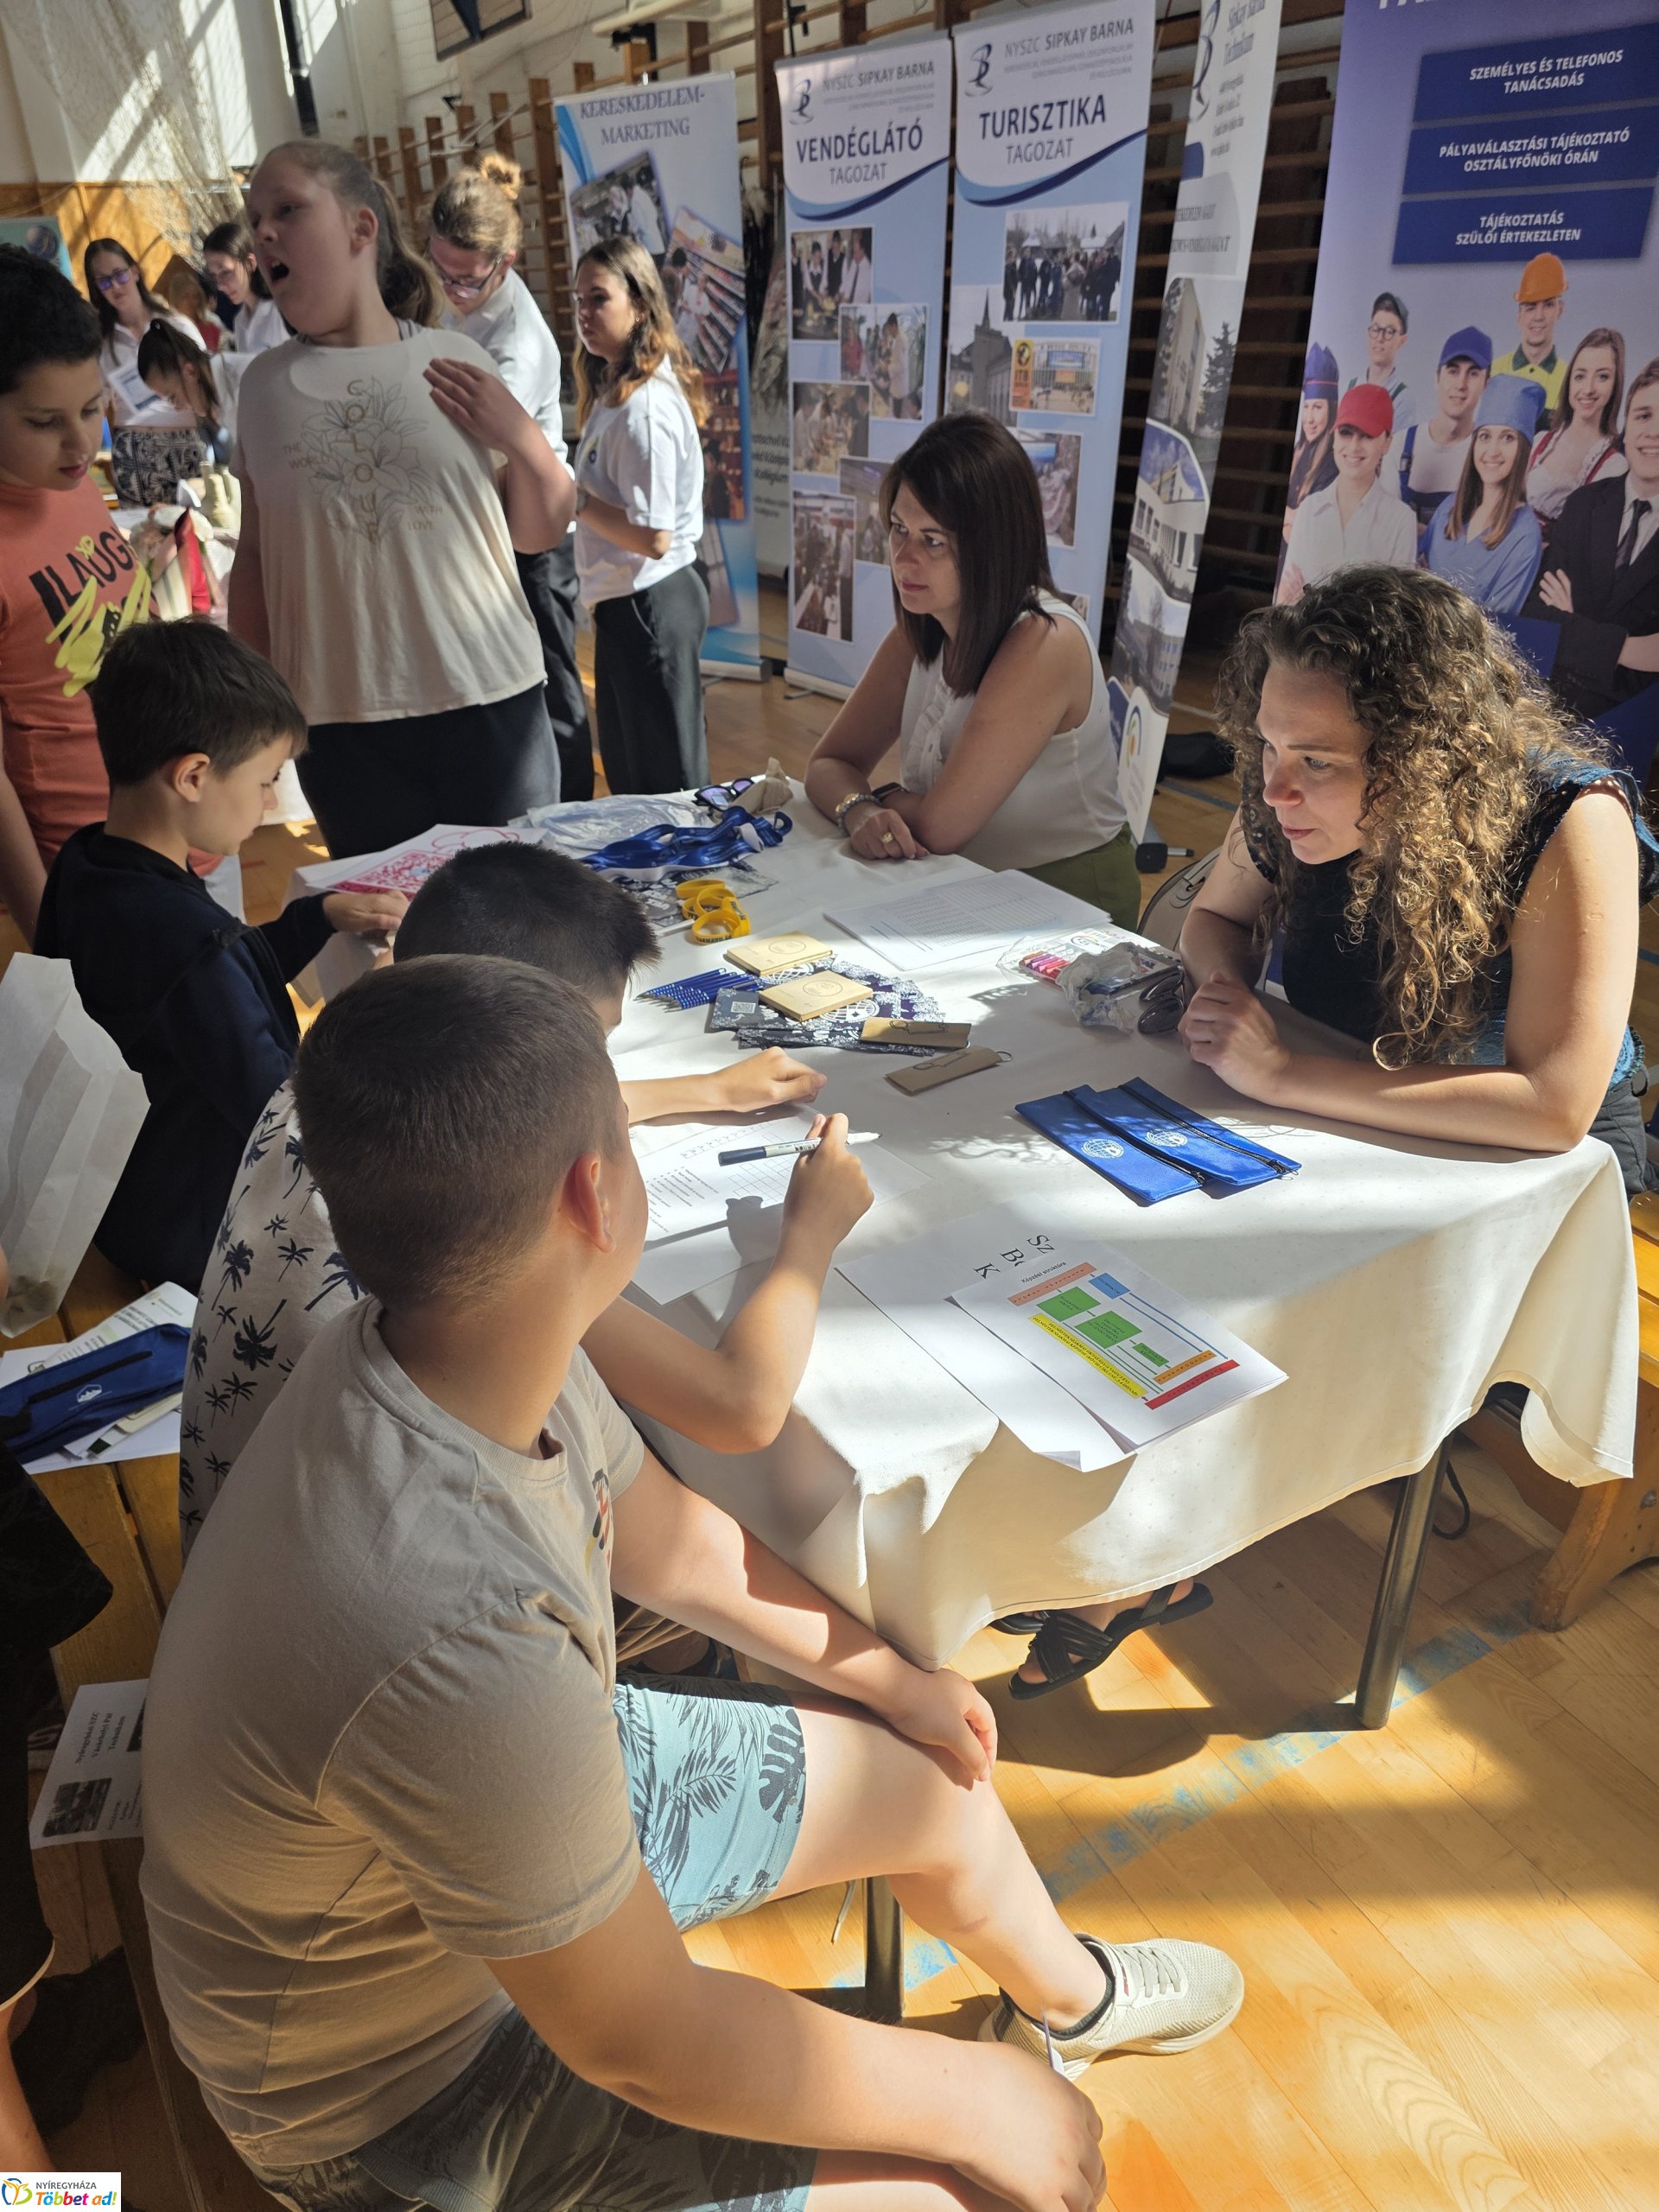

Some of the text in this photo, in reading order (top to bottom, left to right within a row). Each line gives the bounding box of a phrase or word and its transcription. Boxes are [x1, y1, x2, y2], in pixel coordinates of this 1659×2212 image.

[1045, 28, 1088, 51] SIPKAY
[1090, 17, 1135, 42] BARNA
[857, 67, 893, 87] SIPKAY
[896, 60, 935, 80] BARNA
[1469, 48, 1624, 80] SZEMÉLYES ÉS TELEFONOS
[1503, 72, 1585, 94] TANÁCSADÁS
[580, 86, 705, 119] KERESKEDELEM-
[979, 93, 1106, 140] TURISZTIKA
[601, 117, 691, 145] MARKETING
[796, 116, 923, 163] VENDÉGLÁTÓ
[1439, 125, 1630, 158] PÁLYAVÁLASZTÁSI TÁJÉKOZTATÓ
[1006, 137, 1074, 165] TAGOZAT
[1464, 148, 1599, 173] OSZTÁLYFŐNÖKI ÓRÁN
[830, 162, 887, 186] TAGOZAT
[1479, 209, 1565, 231] TÁJÉKOZTATÁS
[1455, 228, 1581, 245] SZÜLŐI ÉRTEKEZLETEN
